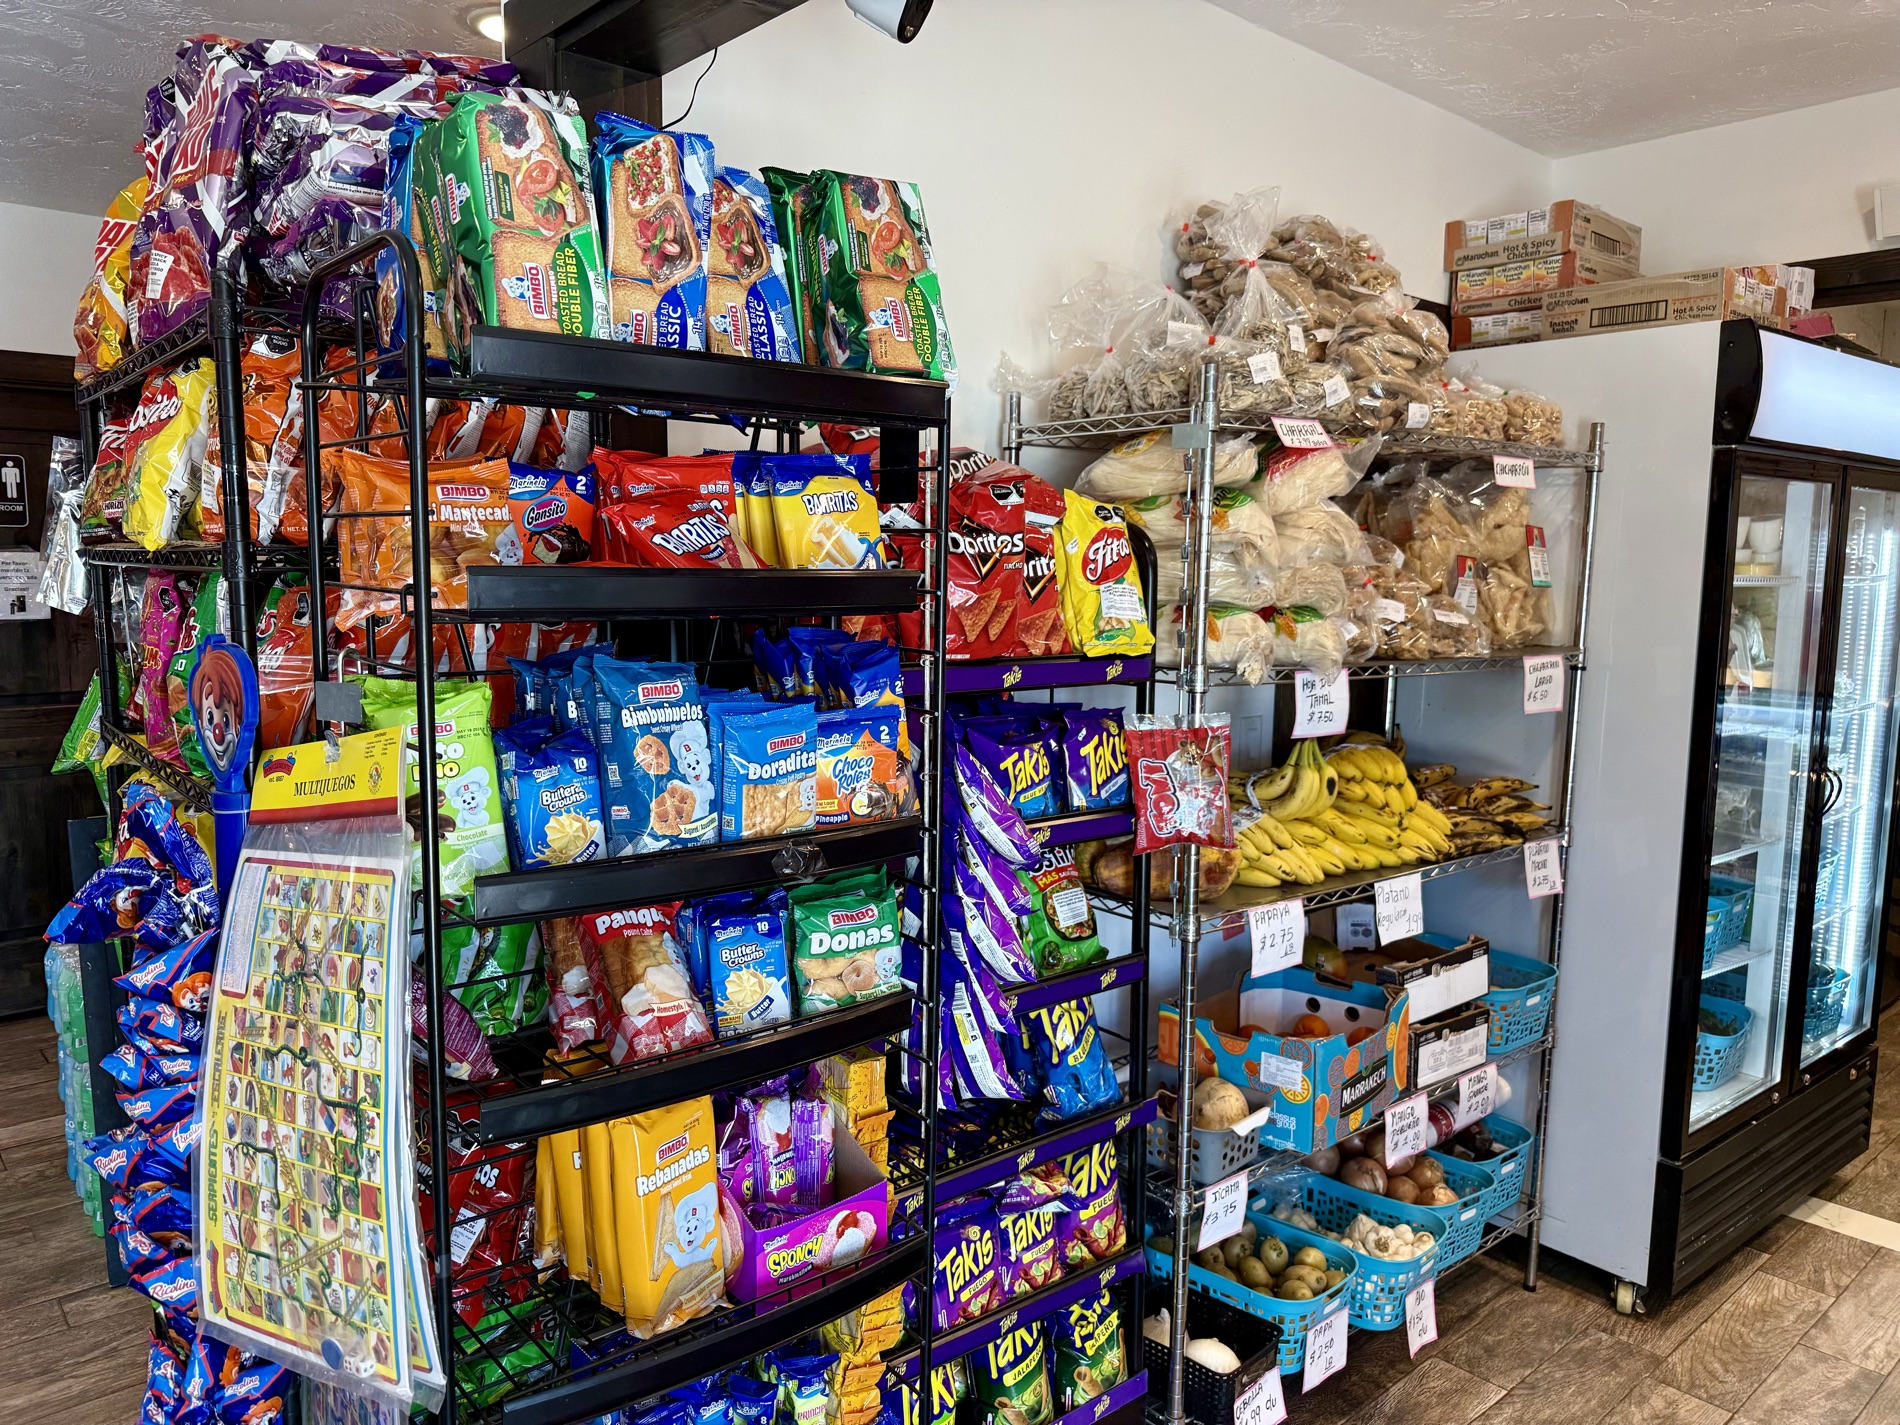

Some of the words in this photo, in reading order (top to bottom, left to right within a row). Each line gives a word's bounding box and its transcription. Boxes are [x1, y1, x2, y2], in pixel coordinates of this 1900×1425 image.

[446, 177, 459, 223] BIMBO
[432, 198, 445, 241] BIMBO
[699, 240, 709, 252] NET
[700, 230, 710, 240] WT
[819, 236, 828, 276] BIMBO
[1463, 249, 1499, 263] Maruchan
[1502, 244, 1519, 255] Hot
[1521, 242, 1529, 250] &
[1531, 238, 1556, 250] Spicy
[1507, 249, 1541, 261] Chicken
[554, 251, 569, 287] BREAD
[563, 247, 580, 286] FIBER
[527, 265, 545, 317] BIMBO
[594, 274, 606, 290] 14
[549, 306, 559, 320] SAY
[556, 288, 573, 335] TOASTED
[566, 288, 584, 338] OUBLE
[748, 295, 758, 323] BREAD
[906, 289, 918, 317] BREAD
[912, 287, 926, 316] FIBER
[1553, 298, 1589, 308] Maruchan
[1672, 306, 1688, 315] Hot
[1696, 302, 1717, 314] Spicy
[658, 301, 670, 333] BREAD
[691, 321, 704, 335] 14
[729, 305, 742, 348] BIMBO
[774, 313, 786, 326] 14
[888, 300, 905, 338] BIMBO
[1549, 318, 1579, 329] Instant
[754, 299, 773, 361] CLASSIC
[912, 318, 924, 355] TOASTED
[919, 318, 933, 363] DOUBLE
[1551, 325, 1576, 335] Lunch
[751, 327, 763, 360] OASTED
[1279, 422, 1324, 438] CHARRAL
[440, 486, 487, 498] BIMBO
[509, 475, 549, 489] Marinela
[575, 475, 587, 491] 2
[801, 488, 860, 516] BARRITAS
[526, 501, 567, 527] Gansito
[948, 531, 1025, 555] Doritos
[1002, 667, 1023, 688] Takis
[1105, 661, 1124, 681] Takis
[1534, 674, 1554, 689] LARGO
[641, 683, 681, 698] BIMBO
[1306, 692, 1335, 709] TAMAL
[621, 702, 704, 729] Bimbuñuelos
[1306, 710, 1334, 725] $7.50
[769, 735, 804, 751] BIMBO
[817, 734, 852, 748] Marinela
[879, 725, 890, 740] 2
[573, 757, 588, 770] 10
[748, 749, 817, 781] Doradita
[832, 755, 874, 780] Choco
[293, 774, 356, 797] MULTIJUEGOS
[837, 769, 872, 796] Roles
[999, 746, 1051, 805] Takis
[540, 784, 583, 807] Butter
[612, 807, 628, 815] BIMBO
[816, 814, 849, 824] Pineapple
[456, 829, 488, 842] Chocolate
[575, 843, 598, 863] Butter
[1038, 871, 1059, 888] MÁS
[1376, 885, 1410, 906] Platano
[756, 921, 769, 933] 10
[831, 907, 877, 926] BIMBO
[1253, 903, 1291, 929] PAPAYA
[1405, 911, 1423, 934] 1.99
[810, 923, 895, 956] Donas
[1259, 926, 1294, 954] $2.75
[721, 943, 759, 962] Butter
[129, 960, 166, 989] Ricolino
[1100, 967, 1118, 989] Takis
[656, 1005, 684, 1014] Homestyle
[751, 999, 772, 1018] Butter
[160, 1058, 191, 1075] Ricolino
[1341, 1065, 1387, 1107] MARRAKECH
[1467, 1069, 1488, 1090] MANGO
[1114, 1112, 1132, 1134] Takis
[1276, 1119, 1297, 1132] group
[1391, 1106, 1415, 1127] MANGO
[658, 1136, 688, 1161] BIMBO
[94, 1148, 127, 1174] Ricolino
[636, 1145, 711, 1198] Rebanadas
[1017, 1149, 1035, 1172] Takis
[207, 1120, 219, 1227] SERPIENTES
[1000, 1209, 1054, 1263] Takis
[767, 1234, 824, 1277] SPONCH
[1030, 1242, 1050, 1259] FUEGO
[939, 1229, 994, 1302] Takis
[1099, 1264, 1117, 1288] Takis
[149, 1278, 198, 1299] Ricolino
[968, 1275, 988, 1297] FUEGO
[999, 1311, 1018, 1335] Takis
[1312, 1320, 1333, 1345] PAPA
[226, 1375, 260, 1396] Ricolino
[1093, 1396, 1111, 1420] Takis
[1235, 1382, 1265, 1421] CEBOLLA
[760, 1416, 767, 1425] 8
